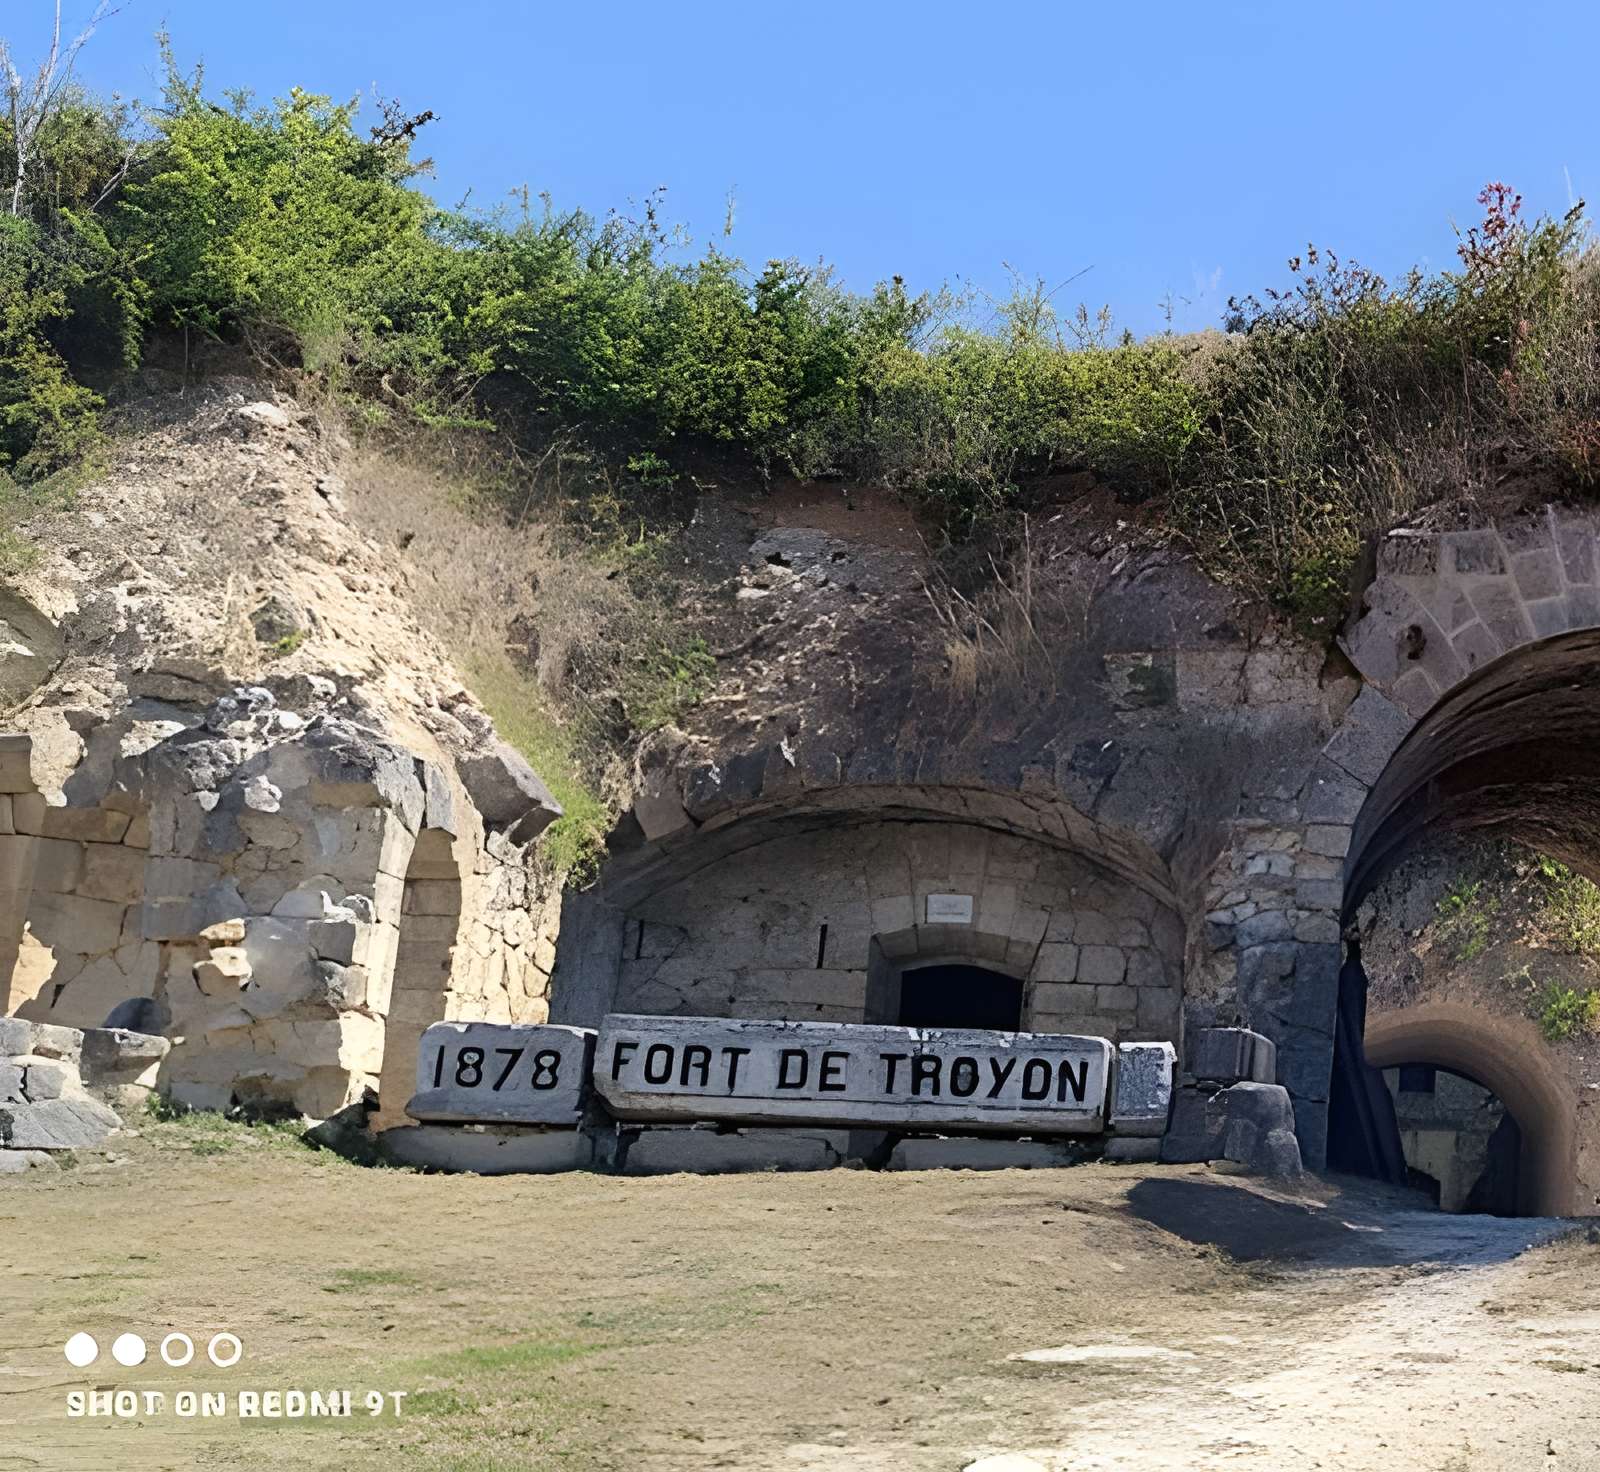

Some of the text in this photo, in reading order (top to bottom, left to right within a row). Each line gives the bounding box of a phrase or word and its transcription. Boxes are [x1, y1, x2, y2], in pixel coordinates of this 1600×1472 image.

[432, 1045, 562, 1092] 1878
[611, 1041, 1090, 1103] FORT DE TROYON
